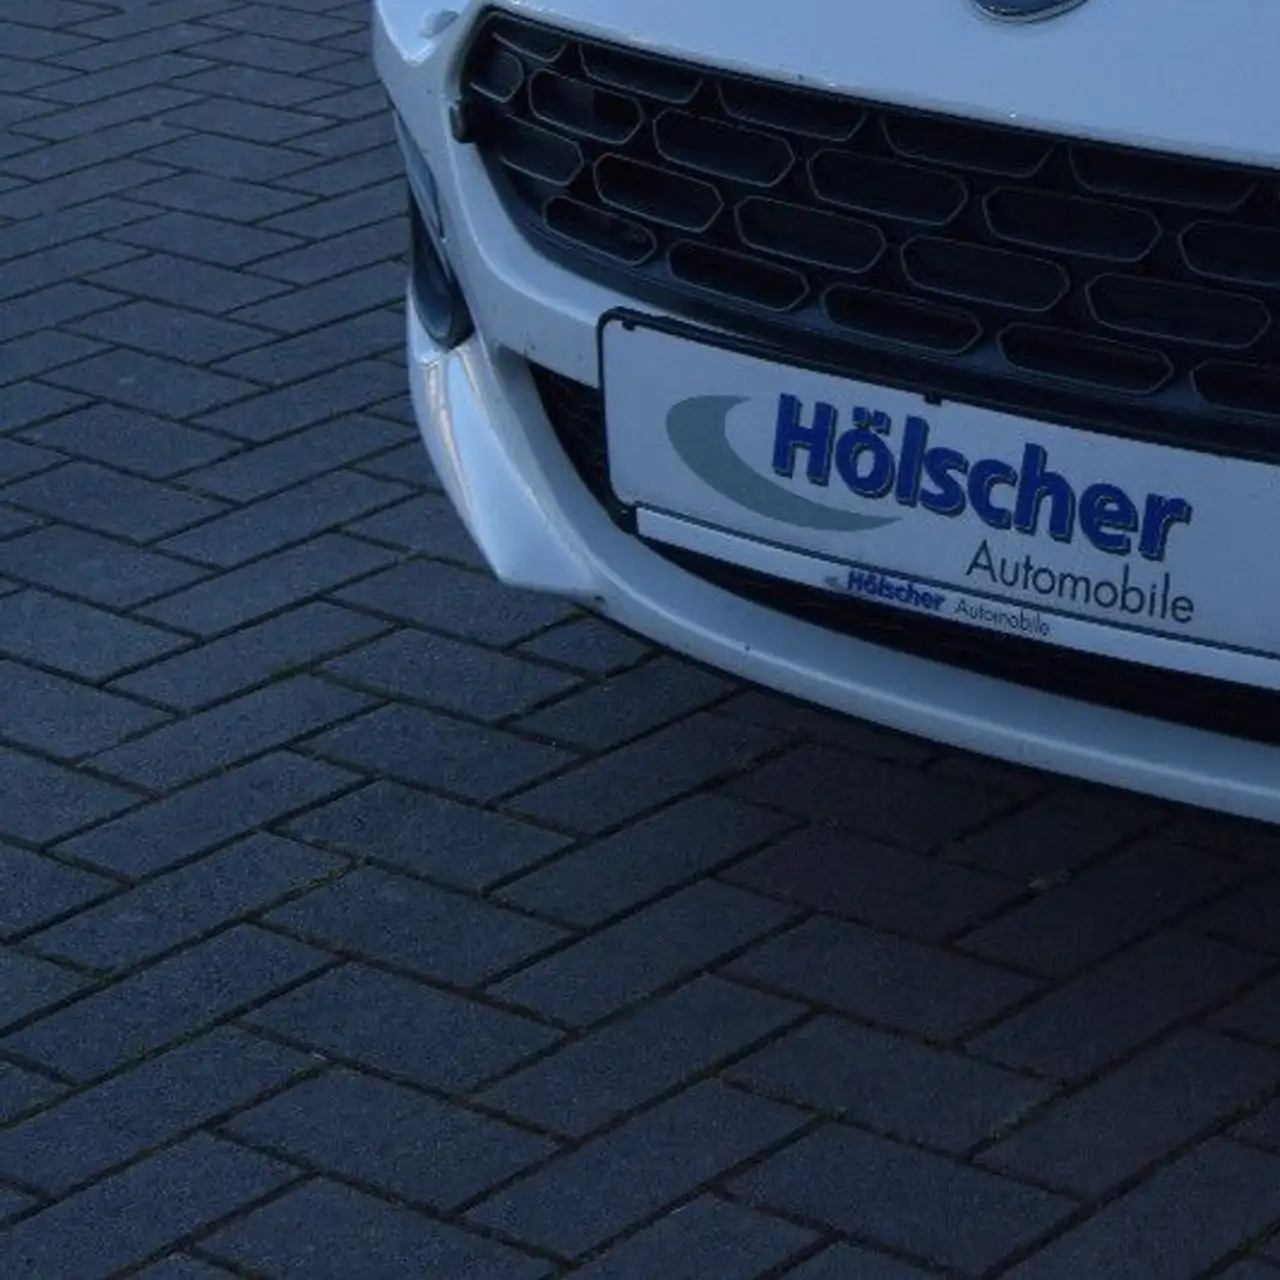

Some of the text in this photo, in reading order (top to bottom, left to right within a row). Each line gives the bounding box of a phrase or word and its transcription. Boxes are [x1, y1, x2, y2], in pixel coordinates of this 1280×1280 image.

[772, 393, 1193, 562] Hölscher
[847, 570, 1050, 636] Hölscher Automobile
[966, 538, 1195, 623] Automobile
